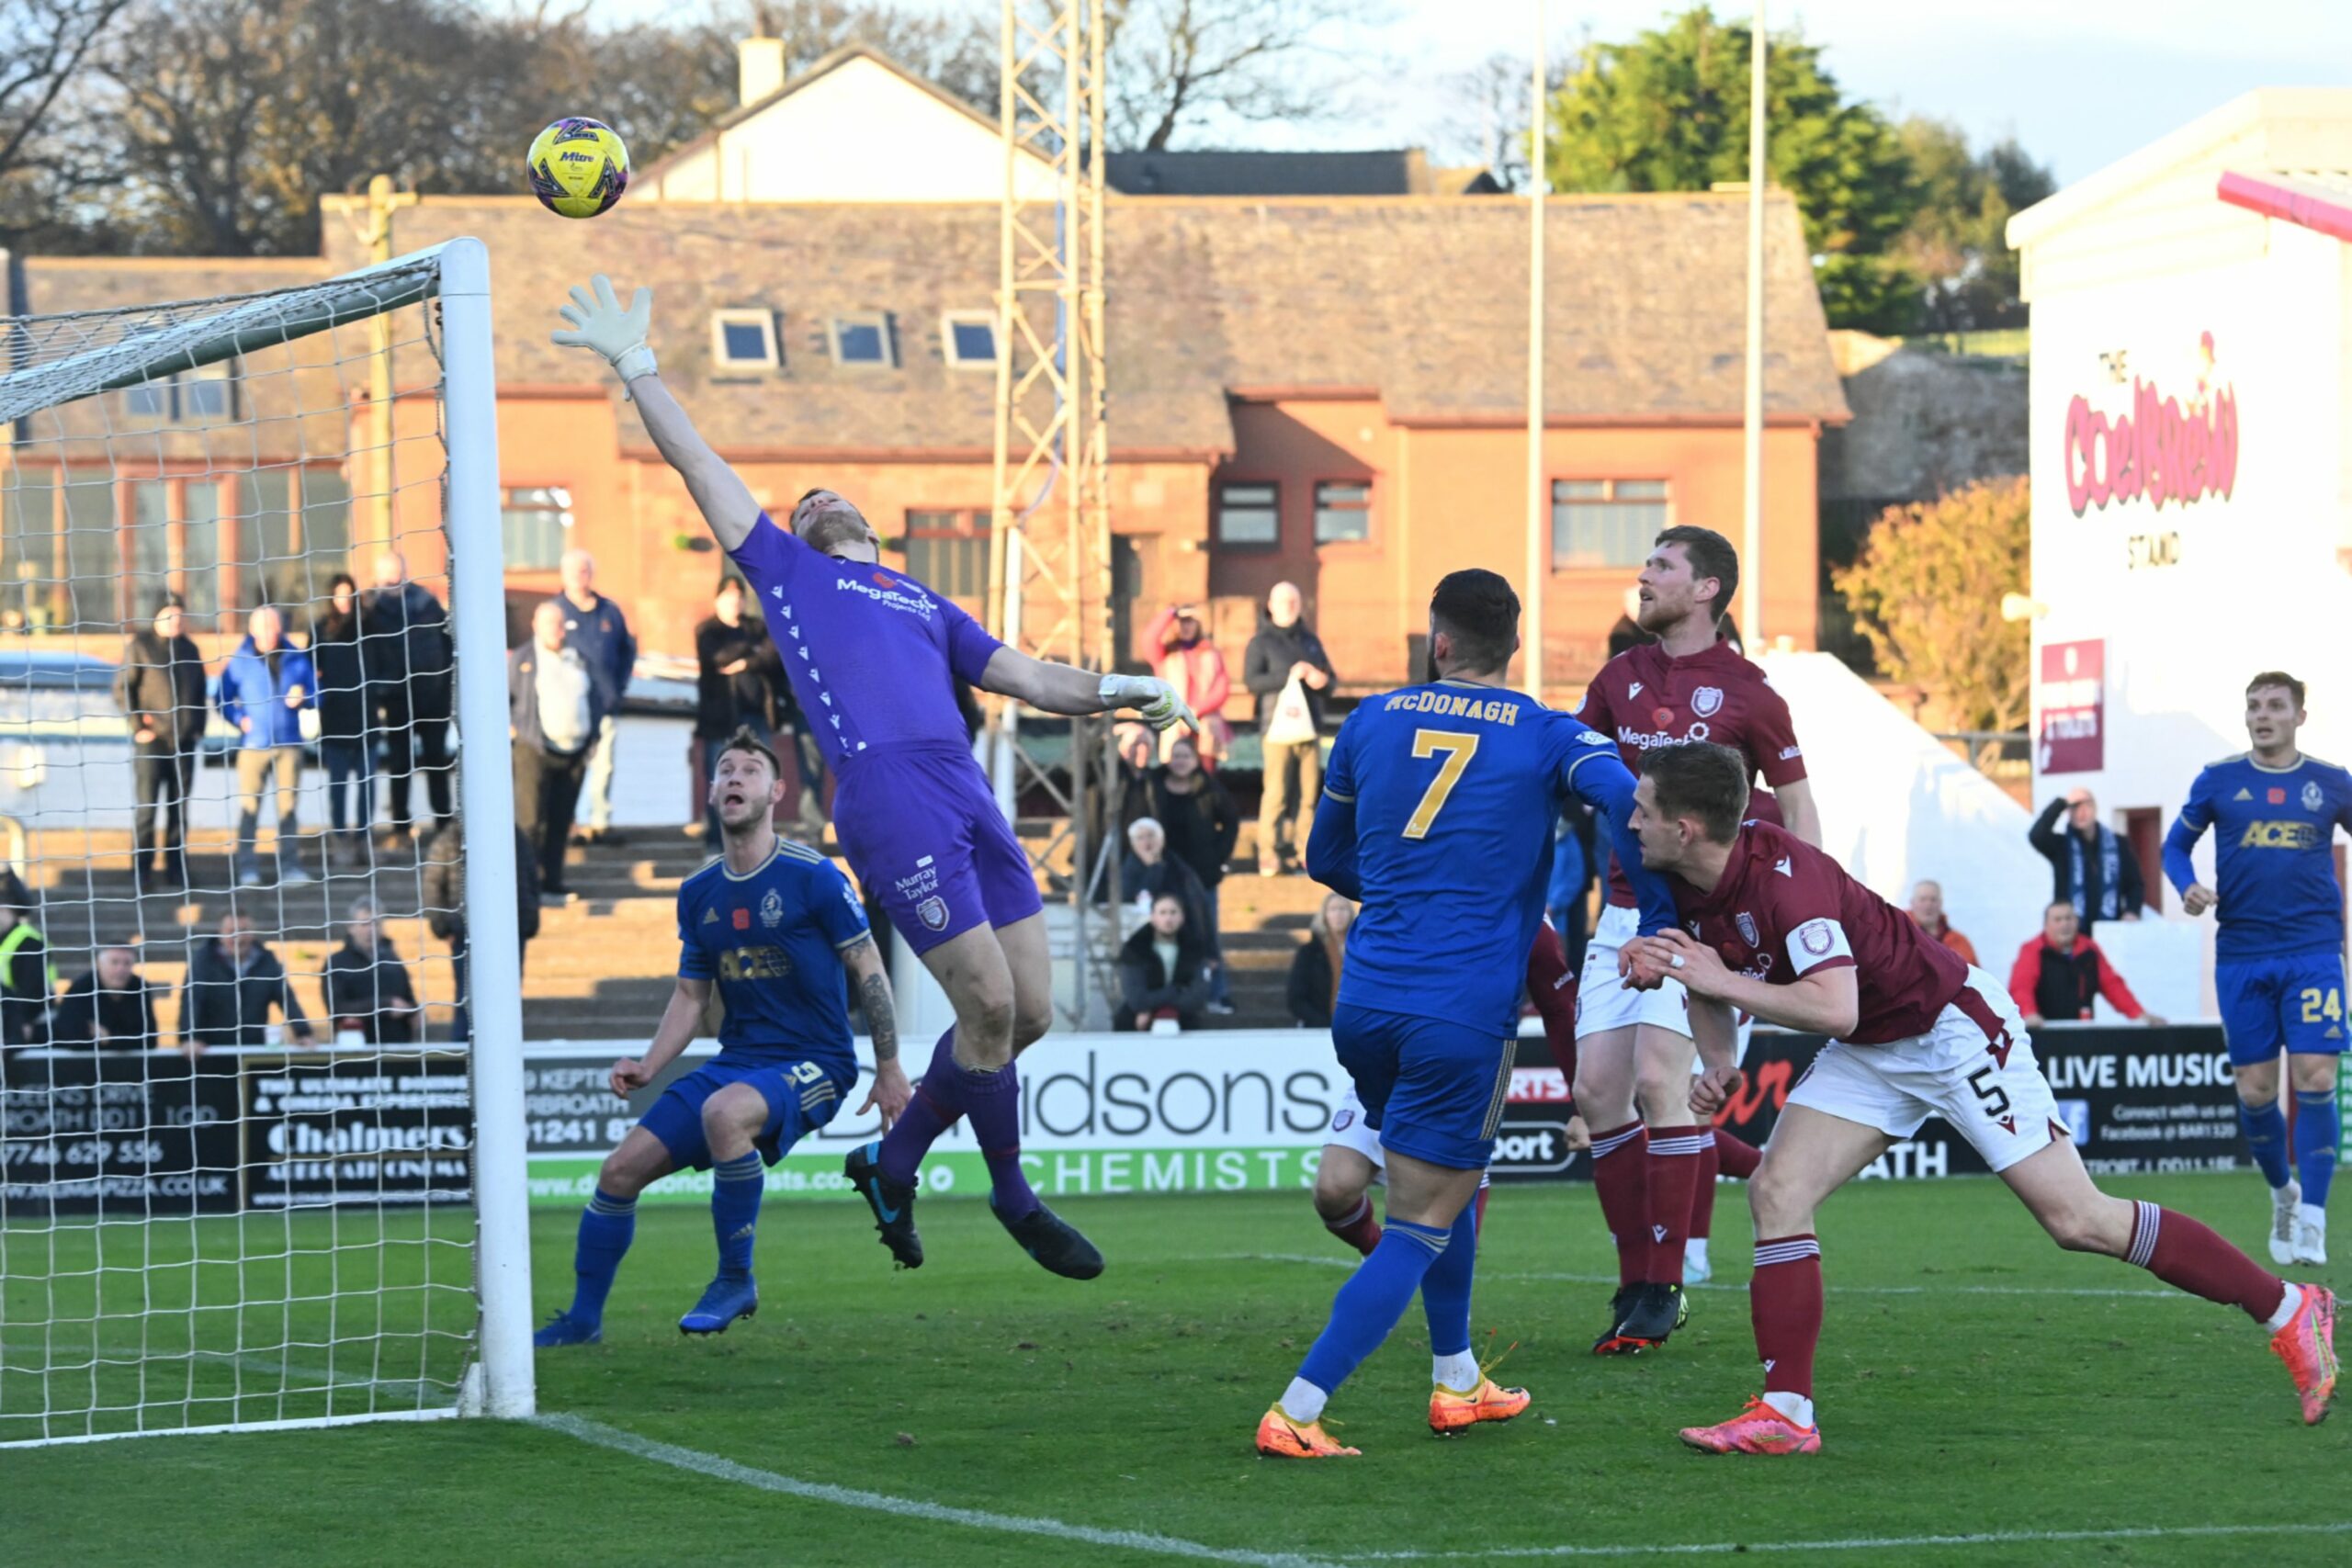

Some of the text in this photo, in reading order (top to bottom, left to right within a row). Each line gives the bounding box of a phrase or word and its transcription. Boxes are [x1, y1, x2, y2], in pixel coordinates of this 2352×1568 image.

[560, 152, 594, 162] Mitre
[1401, 728, 1480, 840] 7
[2239, 820, 2301, 849] ACE
[895, 865, 937, 891] Murray
[903, 879, 939, 899] Taylor
[2301, 987, 2342, 1023] 24
[791, 1061, 823, 1085] 9
[2048, 1052, 2235, 1089] LIVE MUSIC
[526, 1093, 629, 1116] RBROATH
[1967, 1066, 2010, 1118] 5
[2113, 1104, 2166, 1121] Connect
[2169, 1102, 2199, 1118] with
[267, 1121, 466, 1155] Chalmers
[525, 1118, 597, 1144] 1241
[2100, 1124, 2162, 1140] Facebook
[65, 1140, 113, 1164] 629
[117, 1139, 164, 1163] 556
